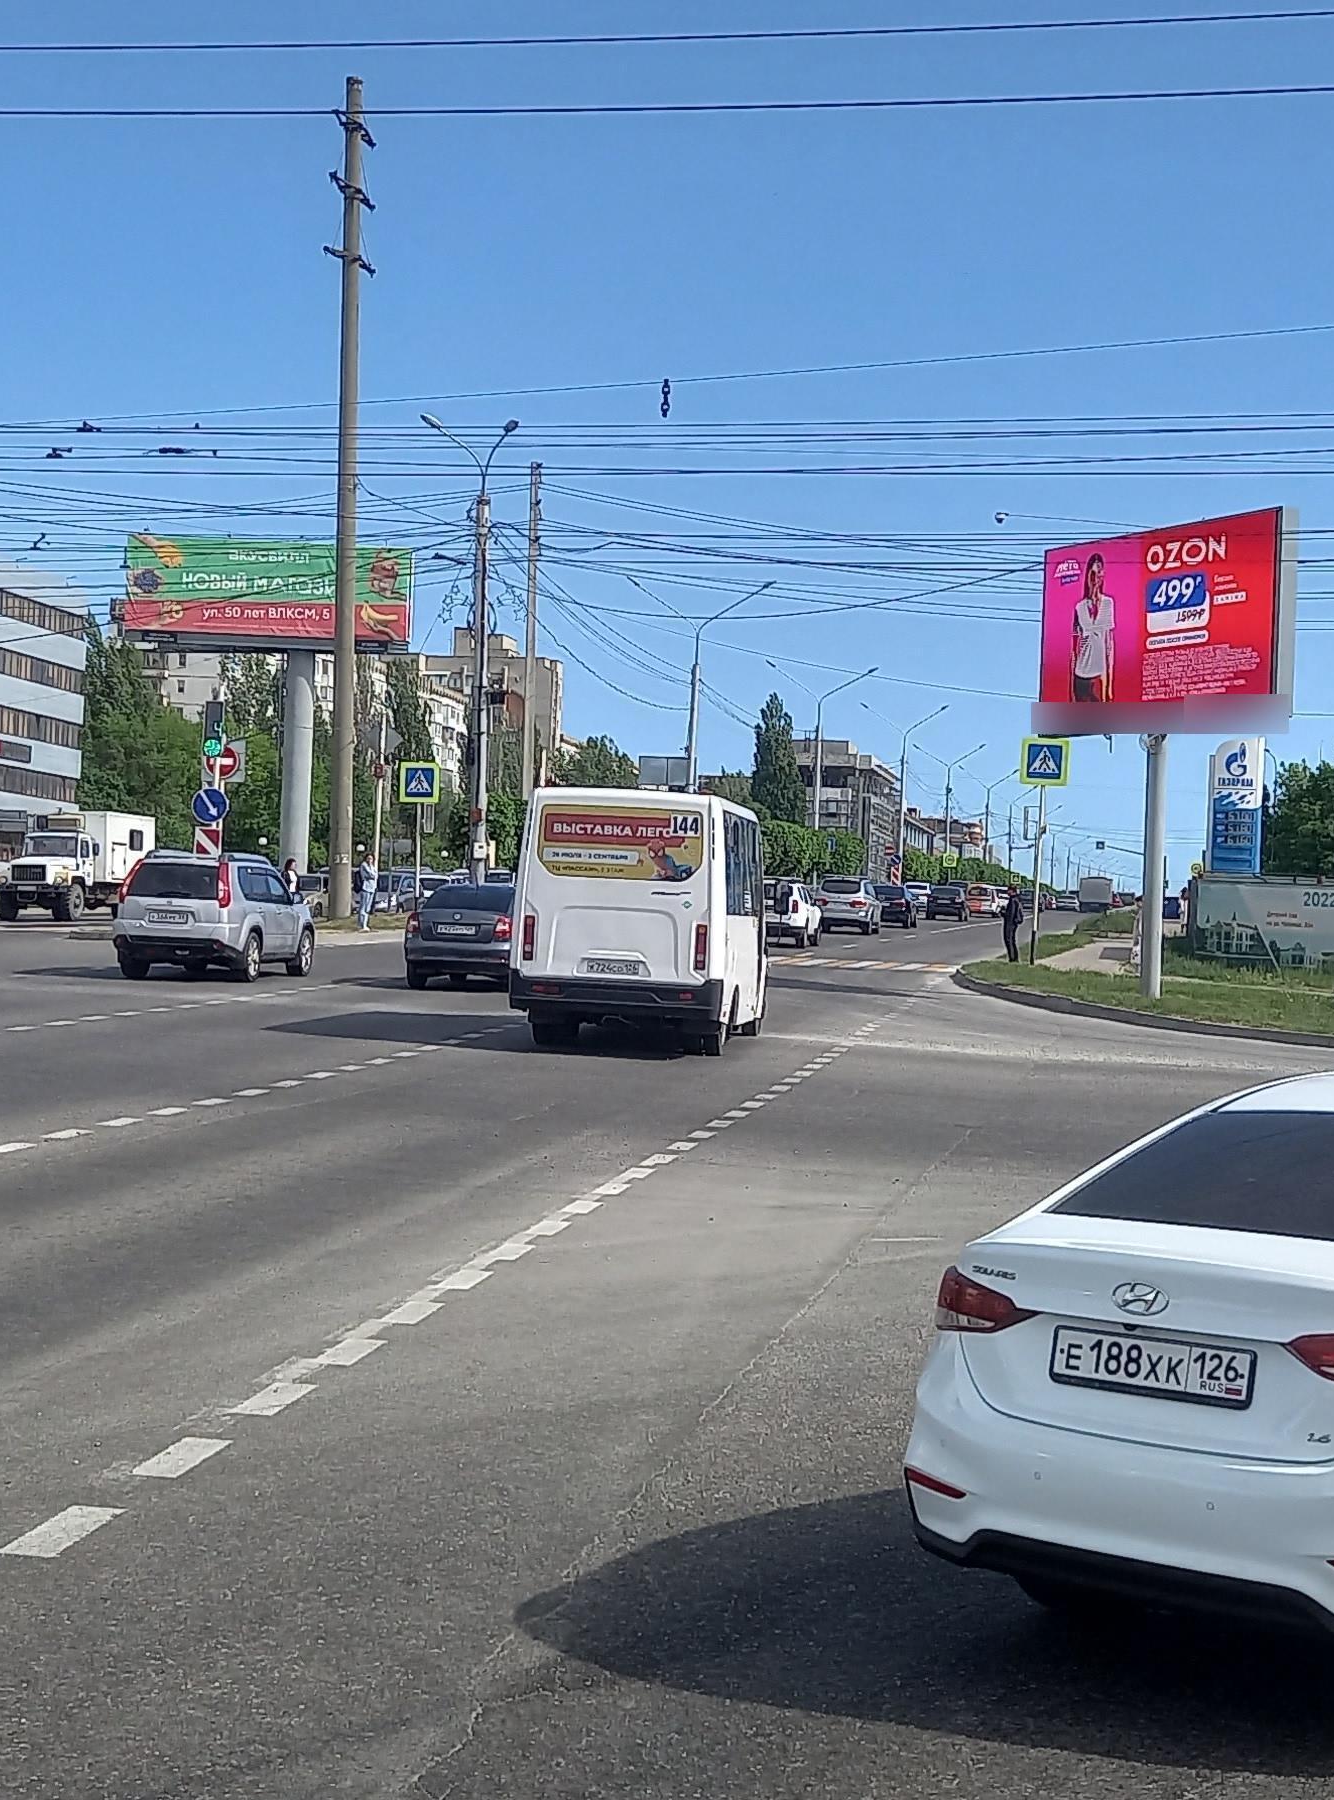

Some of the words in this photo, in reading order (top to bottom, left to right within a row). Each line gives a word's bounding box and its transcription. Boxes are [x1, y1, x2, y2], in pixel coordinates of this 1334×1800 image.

[1146, 533, 1226, 572] OZON
[180, 571, 247, 591] НОВЫЙ
[253, 576, 337, 597] МАГАЗИ
[202, 608, 221, 621] ул.
[224, 606, 240, 618] 50
[244, 608, 266, 619] лет
[268, 609, 320, 621] ВЛКСМ,
[322, 610, 331, 620] 5
[553, 822, 633, 836] ВЫСТАВКА
[672, 815, 700, 835] 144
[1193, 1350, 1239, 1383] 126
[1199, 1380, 1224, 1394] RUS
